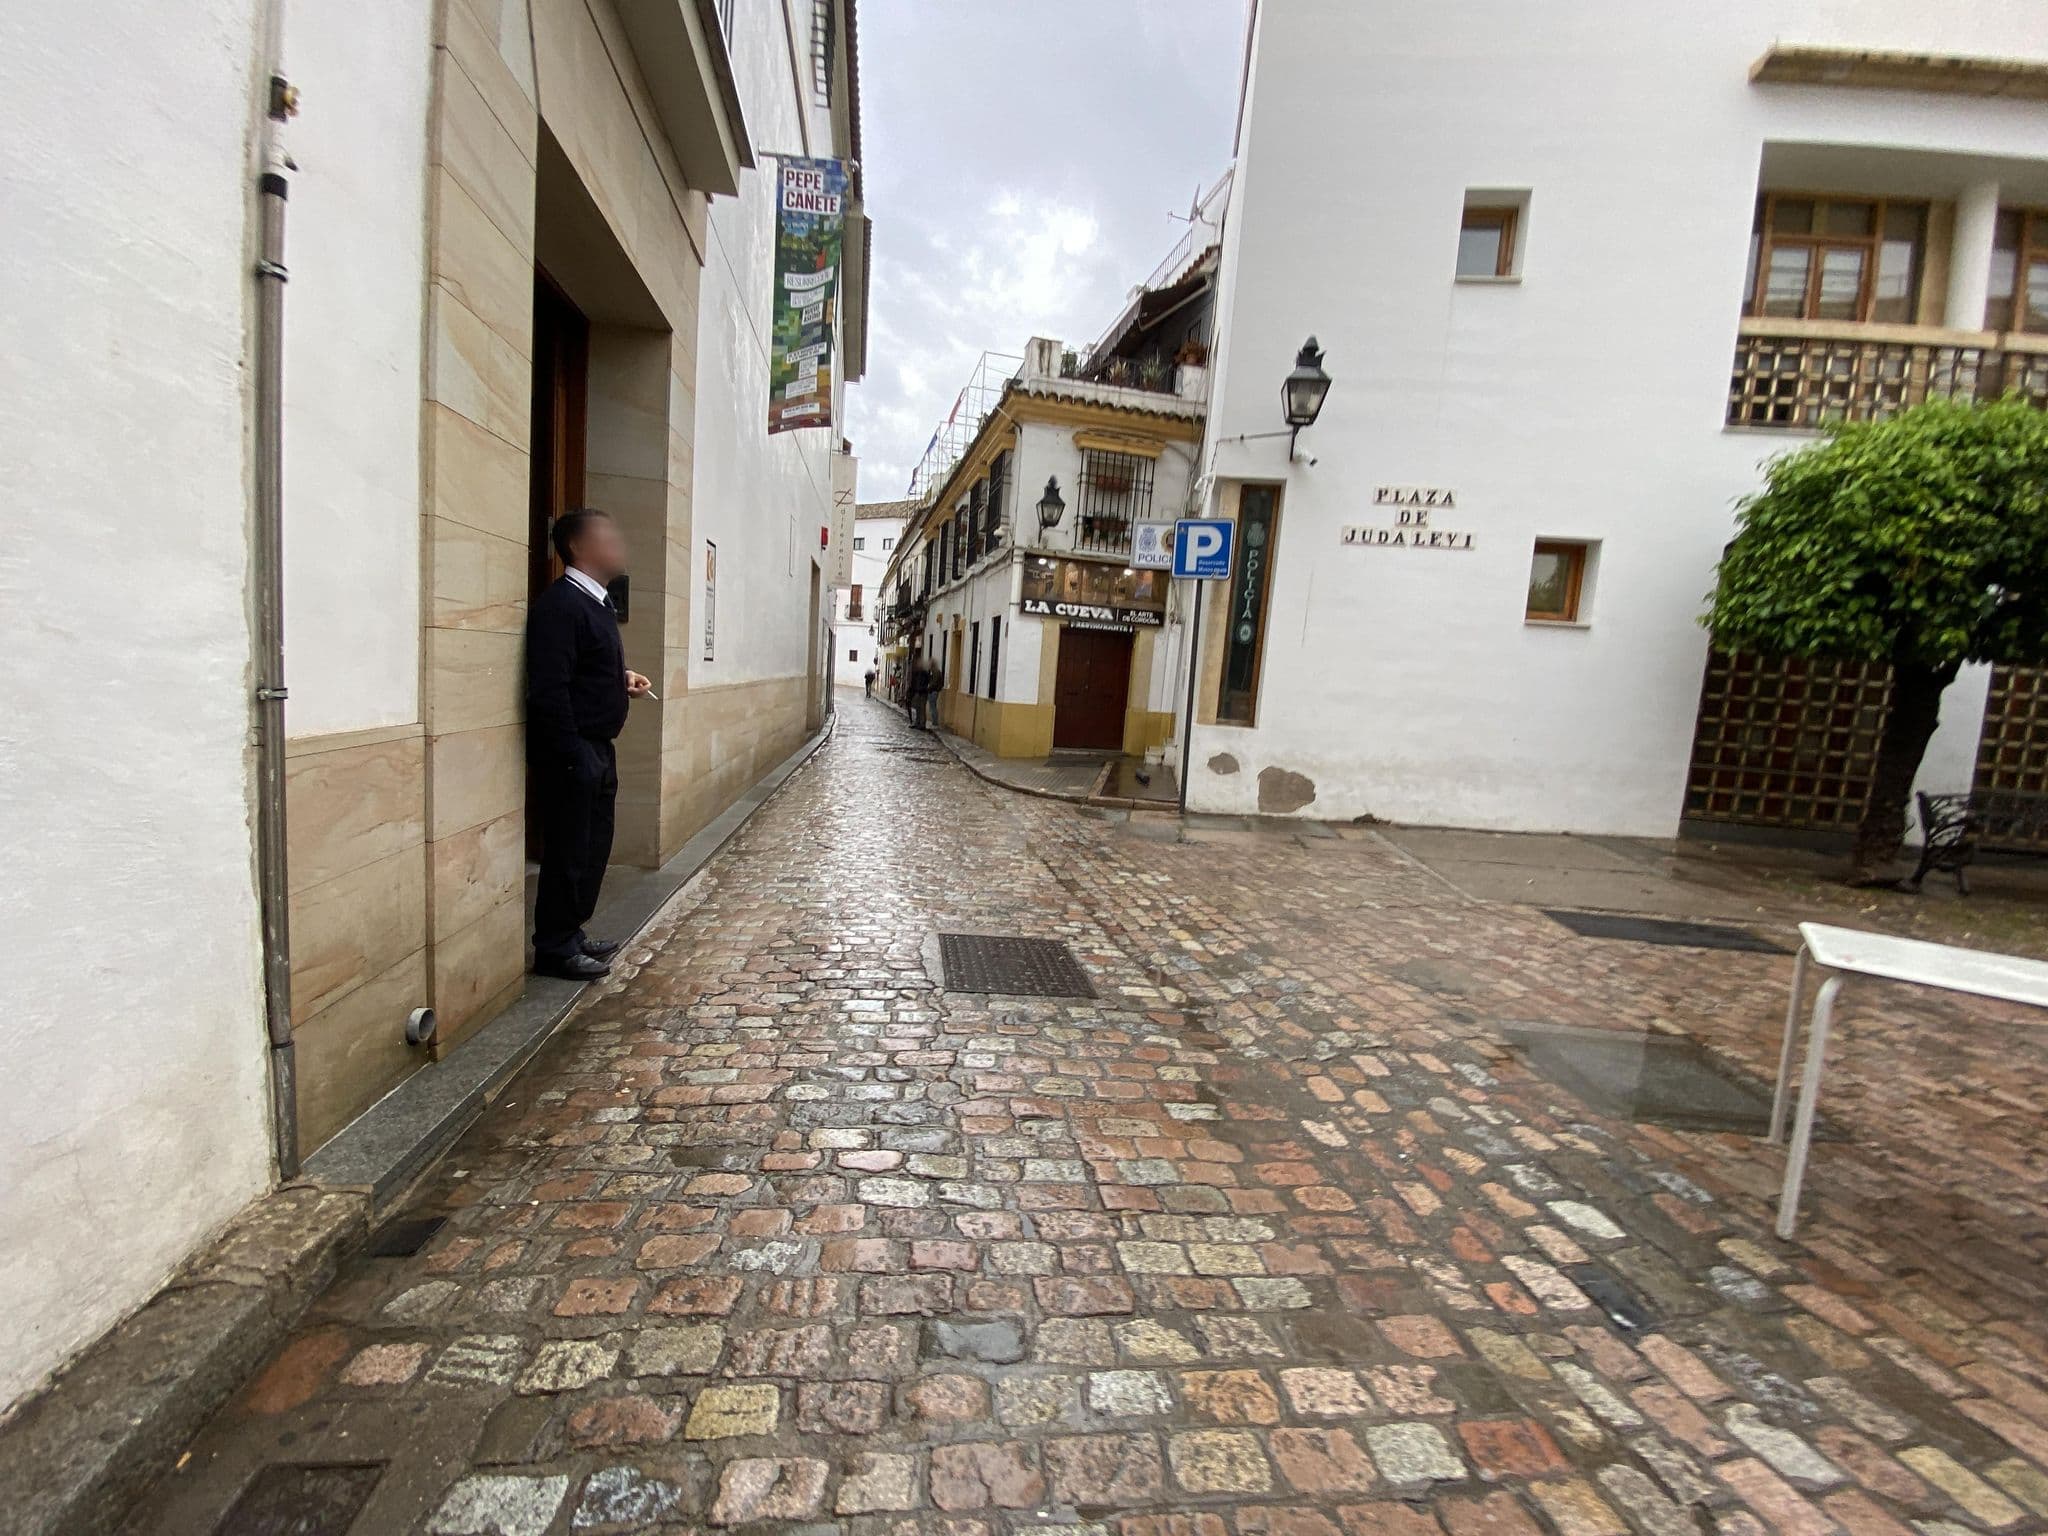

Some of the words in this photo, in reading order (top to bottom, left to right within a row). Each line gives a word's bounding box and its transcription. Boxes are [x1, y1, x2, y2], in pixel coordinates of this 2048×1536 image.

[786, 170, 822, 190] PEPE
[1375, 488, 1454, 505] PLAZA
[1399, 510, 1428, 525] DE
[1185, 525, 1223, 573] P
[1024, 600, 1050, 615] LA
[1055, 602, 1114, 620] CUEVA
